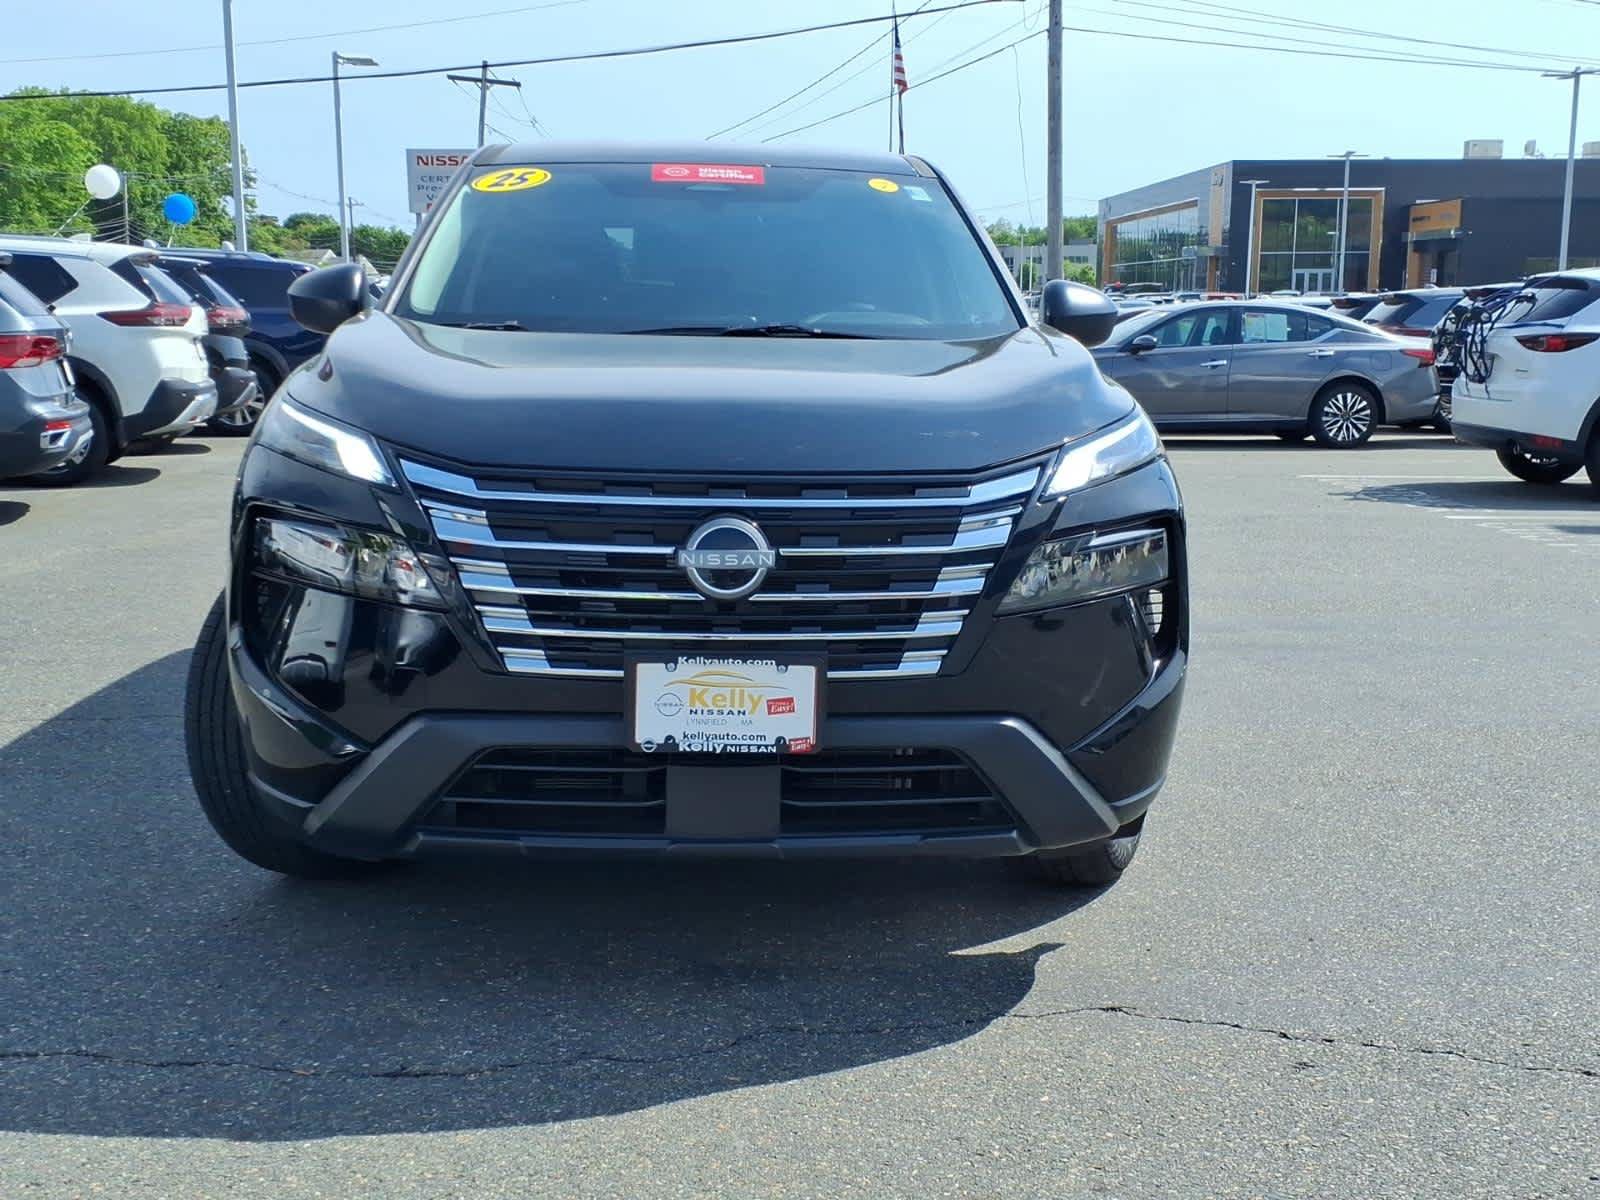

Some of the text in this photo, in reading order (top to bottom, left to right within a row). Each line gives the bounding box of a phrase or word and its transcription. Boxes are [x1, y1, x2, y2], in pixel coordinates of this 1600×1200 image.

[487, 173, 536, 188] 25
[681, 553, 773, 566] NISSAN
[677, 656, 776, 666] Kellyauto.com
[688, 687, 763, 715] Kelly
[683, 731, 767, 742] kellyauto.com
[678, 741, 777, 753] Kelly NISSAN
